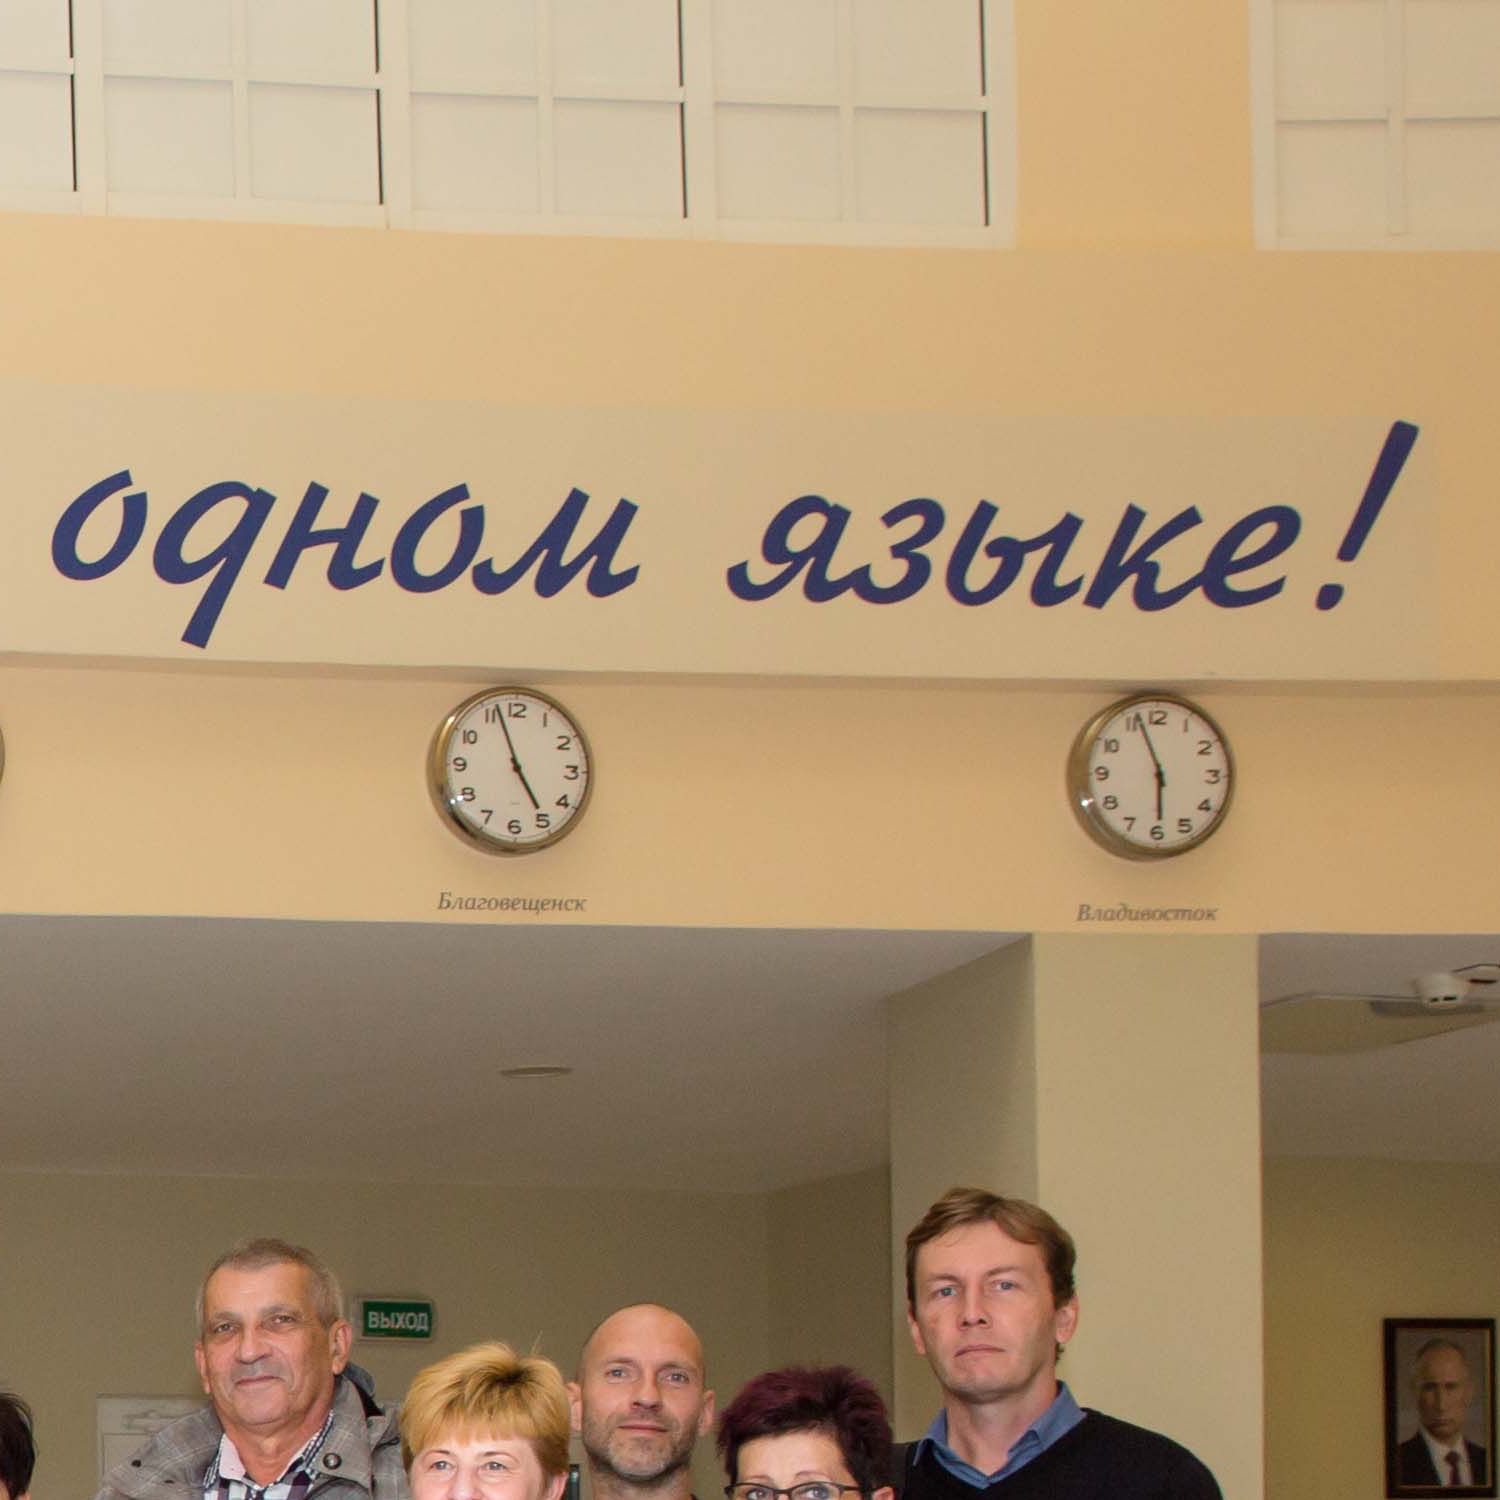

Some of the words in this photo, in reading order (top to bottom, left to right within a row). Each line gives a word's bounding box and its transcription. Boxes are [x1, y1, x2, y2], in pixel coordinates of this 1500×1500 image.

[50, 470, 639, 648] одном
[727, 422, 1418, 612] языке!
[485, 708, 496, 724] 11
[508, 703, 527, 718] 12
[1148, 710, 1168, 725] 12
[543, 712, 547, 728] 1
[1183, 718, 1188, 732] 1
[462, 729, 478, 745] 10
[556, 735, 571, 751] 2
[1104, 738, 1120, 753] 10
[1197, 740, 1212, 755] 2
[452, 757, 467, 772] 9
[563, 765, 579, 781] 3
[1094, 766, 1109, 781] 9
[1205, 769, 1221, 785] 3
[461, 787, 476, 802] 8
[555, 794, 570, 809] 4
[1102, 795, 1118, 810] 8
[1197, 798, 1212, 812] 4
[480, 809, 493, 825] 7
[535, 813, 550, 829] 5
[1123, 816, 1136, 832] 7
[507, 819, 522, 835] 6
[1151, 825, 1165, 840] 6
[1177, 818, 1193, 834] 5
[437, 891, 588, 915] Благовещенск
[1076, 903, 1218, 923] Владивосток
[367, 1310, 429, 1333] ВЫХОД
